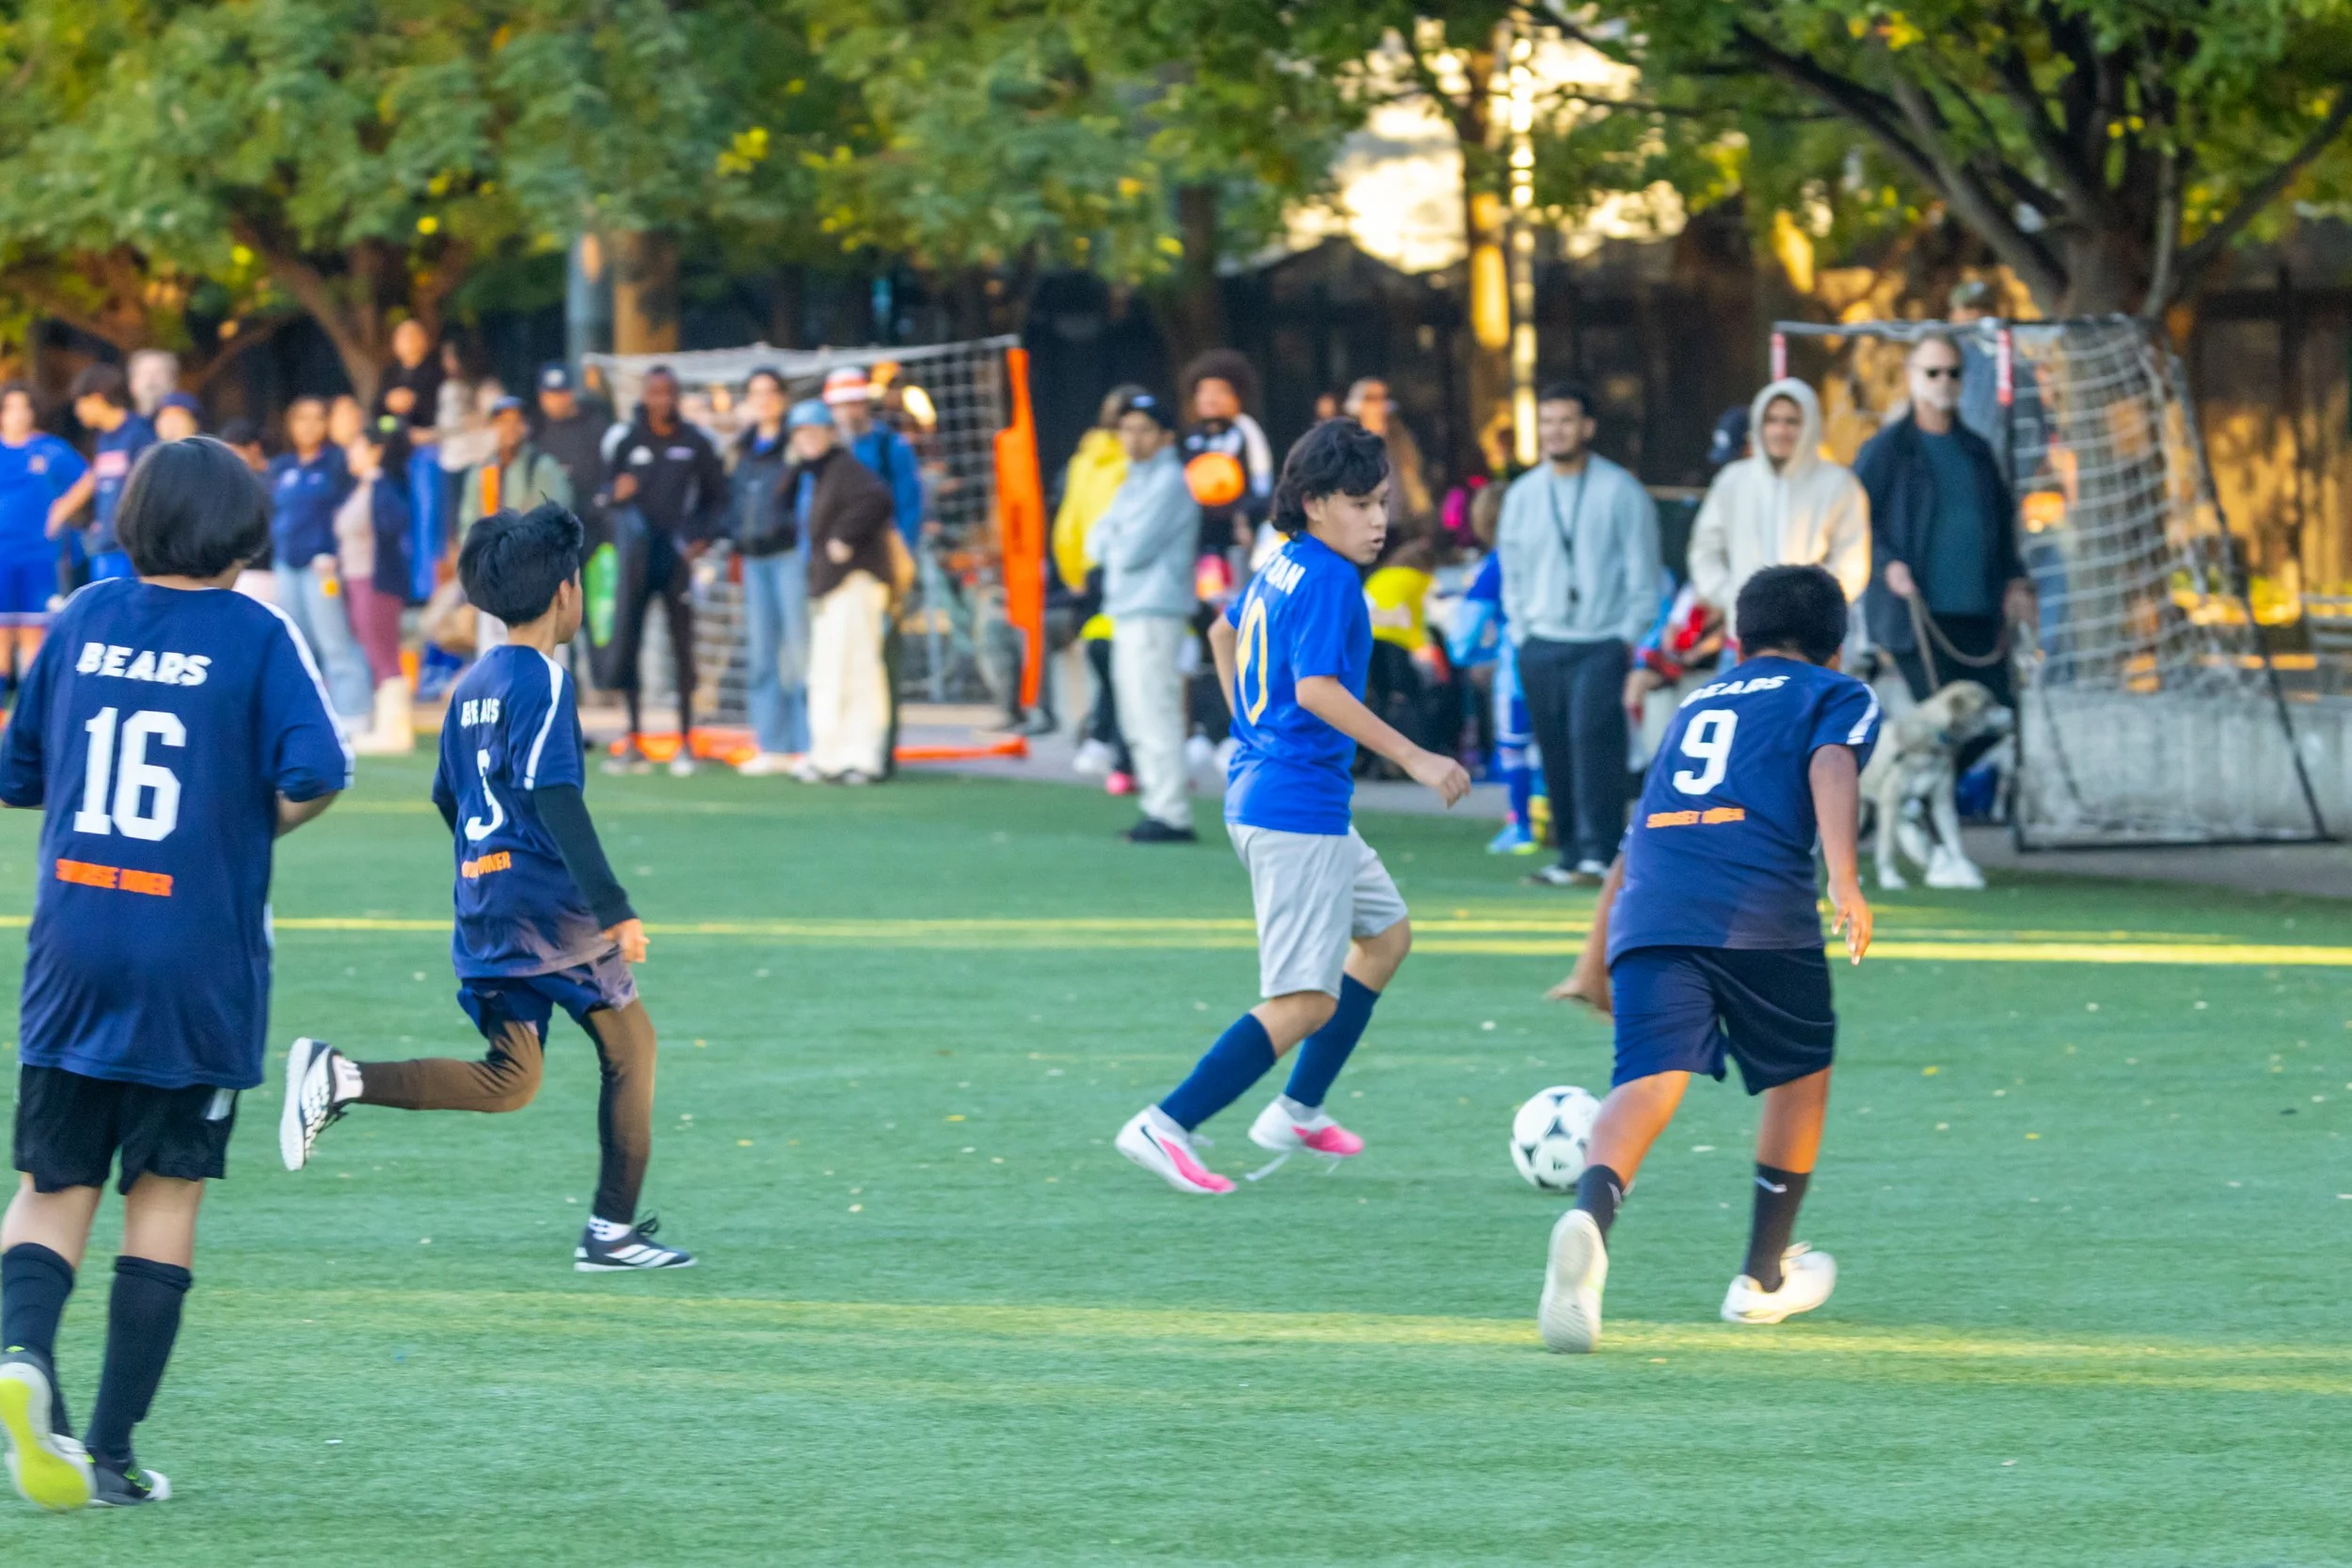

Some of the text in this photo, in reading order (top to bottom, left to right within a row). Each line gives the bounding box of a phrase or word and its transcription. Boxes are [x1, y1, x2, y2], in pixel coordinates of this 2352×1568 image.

[75, 641, 213, 687] BEARS
[73, 706, 187, 842] 16
[1672, 709, 1740, 796] 9
